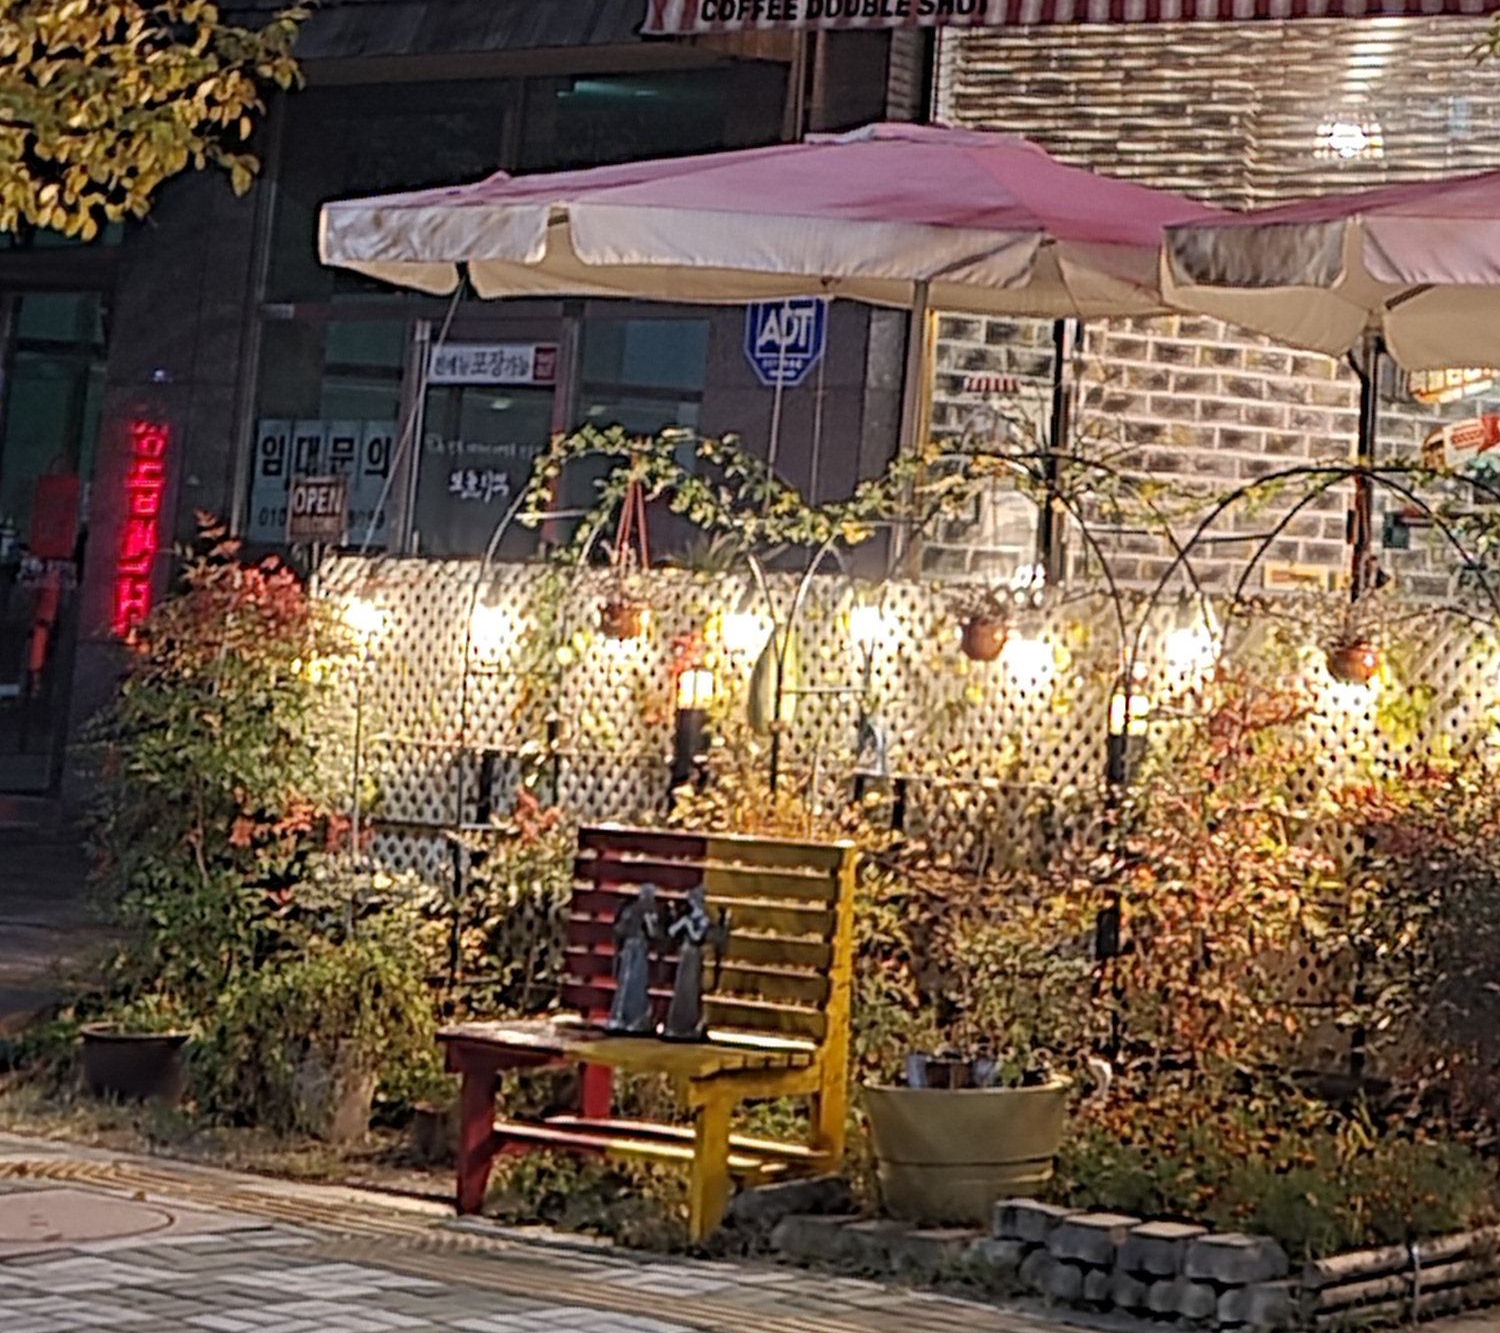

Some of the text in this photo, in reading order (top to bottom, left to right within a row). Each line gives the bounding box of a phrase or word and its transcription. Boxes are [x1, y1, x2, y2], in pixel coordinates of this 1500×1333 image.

[758, 307, 816, 348] ADT
[261, 434, 393, 479] 임대문의
[292, 485, 345, 517] OPEN
